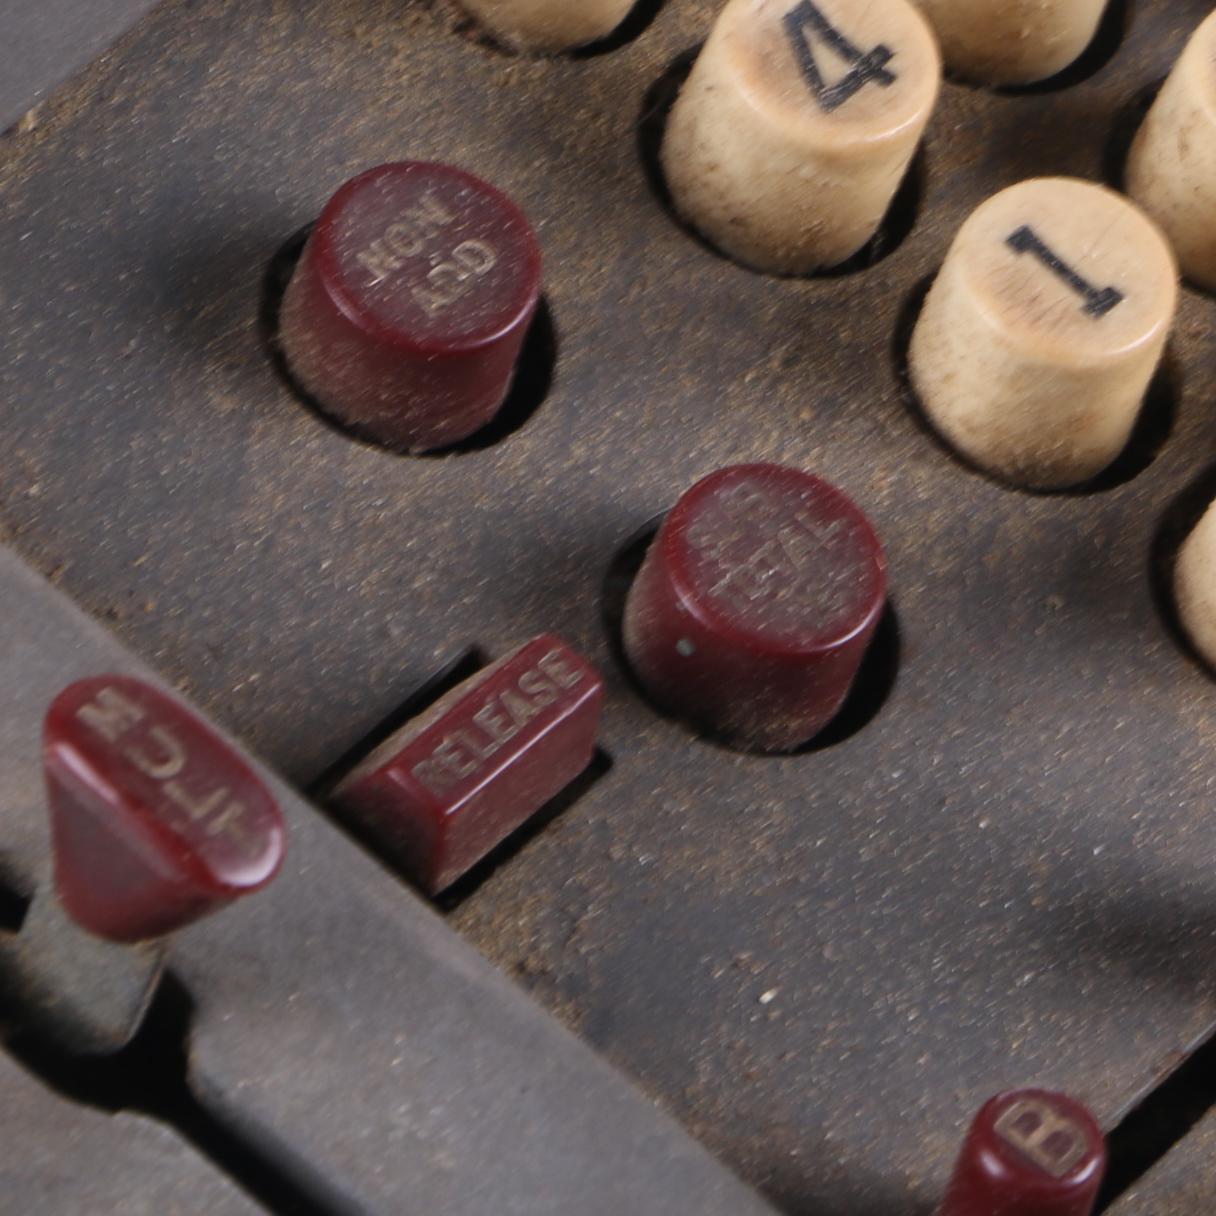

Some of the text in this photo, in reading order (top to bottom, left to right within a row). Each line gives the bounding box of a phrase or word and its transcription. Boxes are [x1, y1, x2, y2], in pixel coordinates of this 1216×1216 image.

[1004, 224, 1127, 320] 1
[411, 648, 585, 798] RELEASE
[992, 1099, 1090, 1179] B
